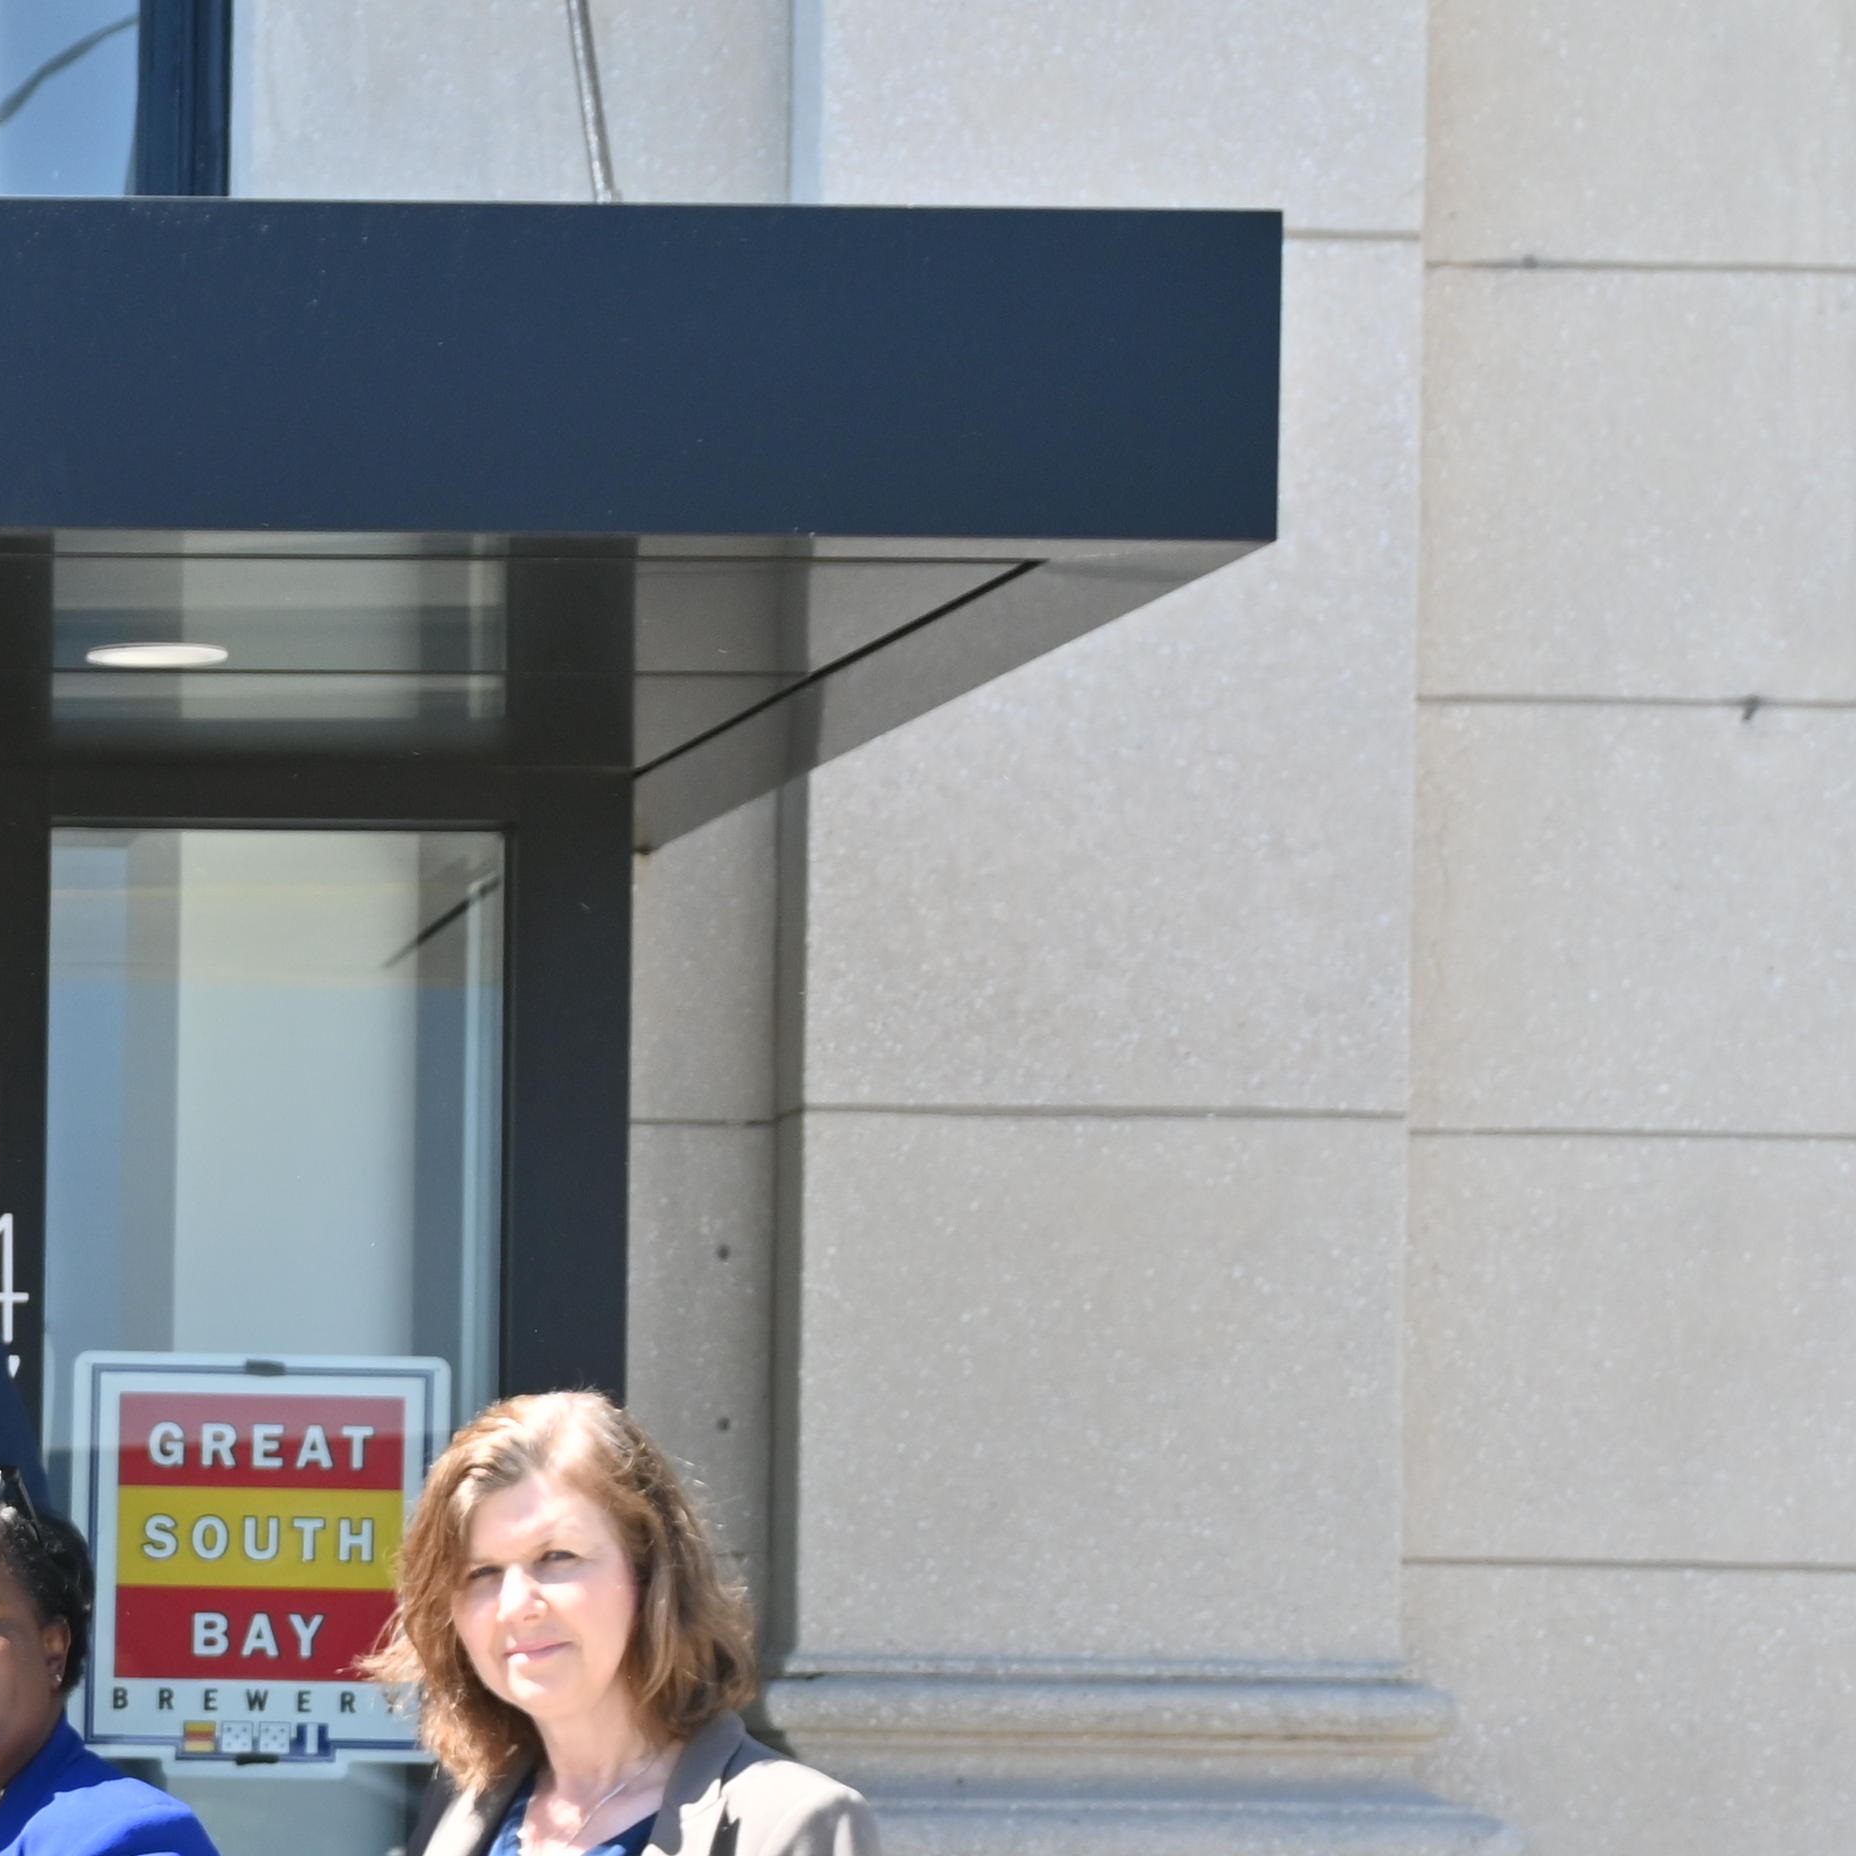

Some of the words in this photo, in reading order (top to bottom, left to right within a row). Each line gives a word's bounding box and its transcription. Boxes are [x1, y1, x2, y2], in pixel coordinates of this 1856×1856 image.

[148, 1421, 375, 1470] GREAT
[141, 1513, 374, 1563] SOUTH
[191, 1611, 324, 1658] BAY
